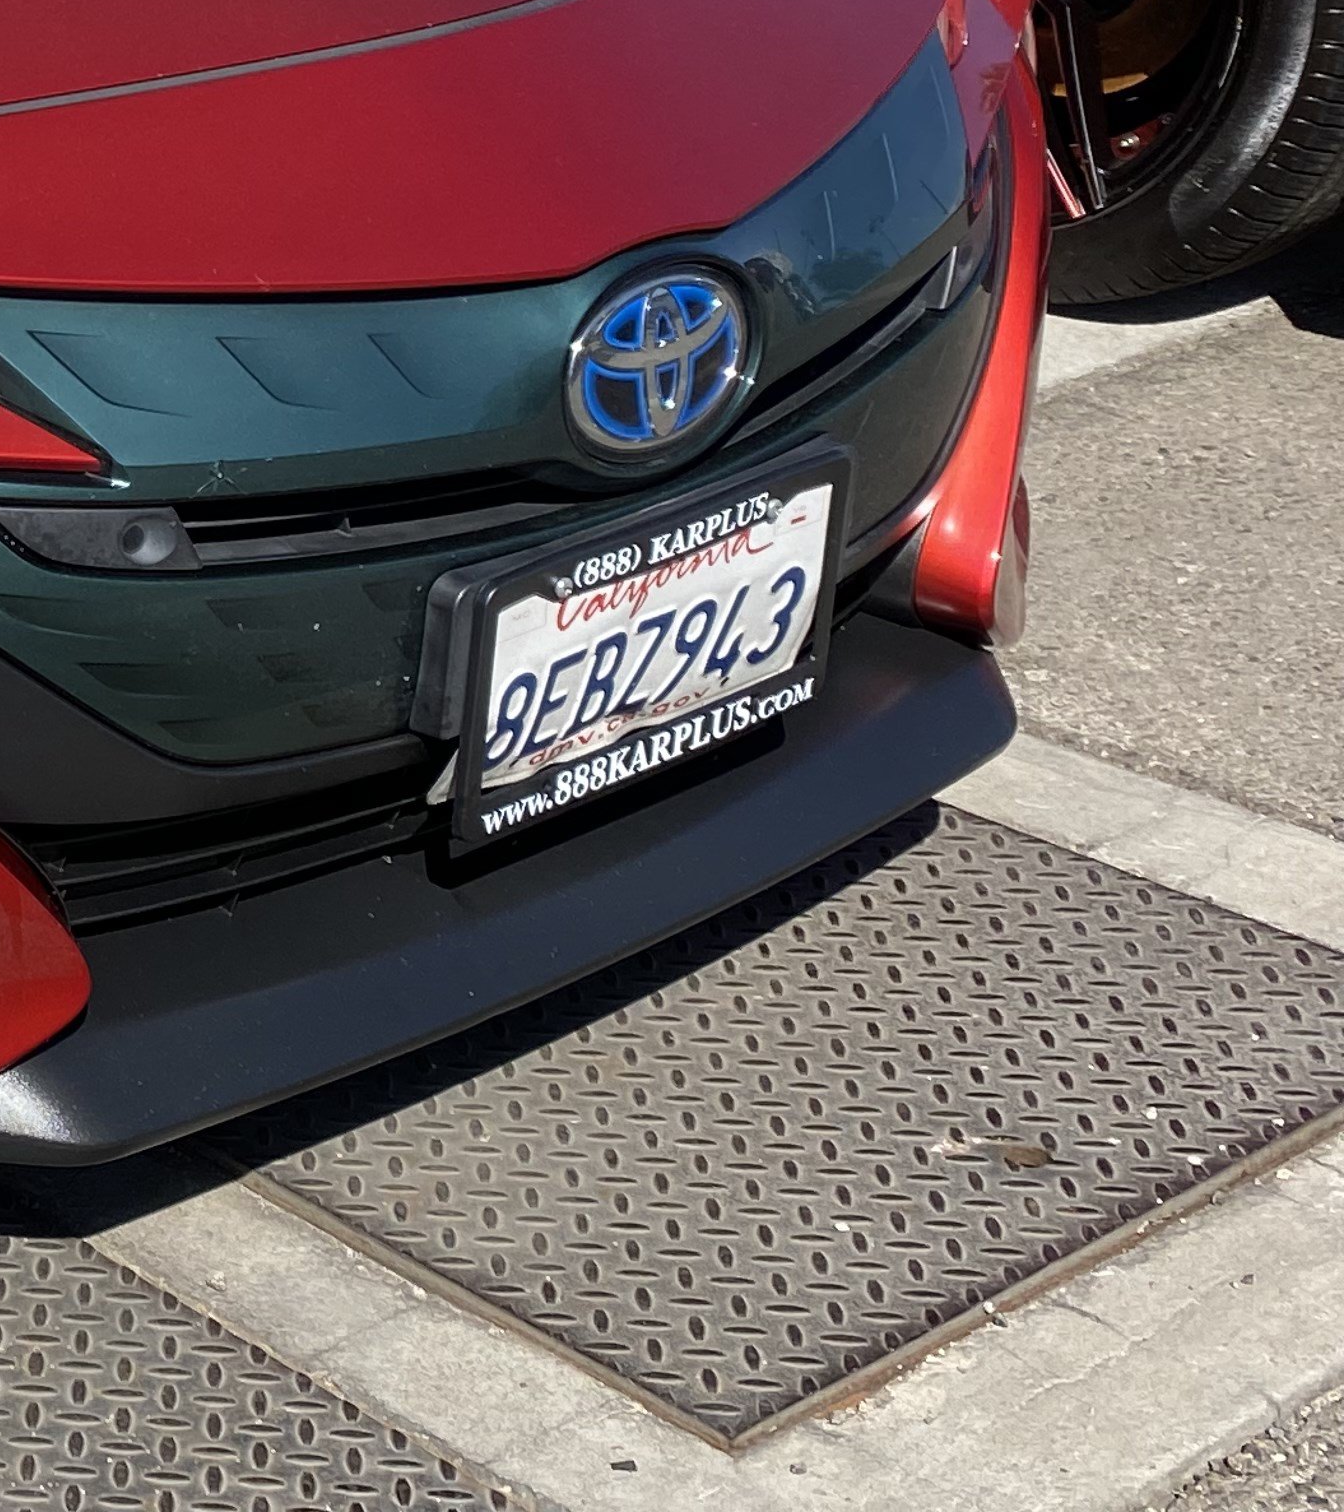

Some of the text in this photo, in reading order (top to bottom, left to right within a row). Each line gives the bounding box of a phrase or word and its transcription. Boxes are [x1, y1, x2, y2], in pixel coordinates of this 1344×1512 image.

[573, 491, 770, 588] (888) KARPLUS
[481, 566, 807, 773] 8EBZ943
